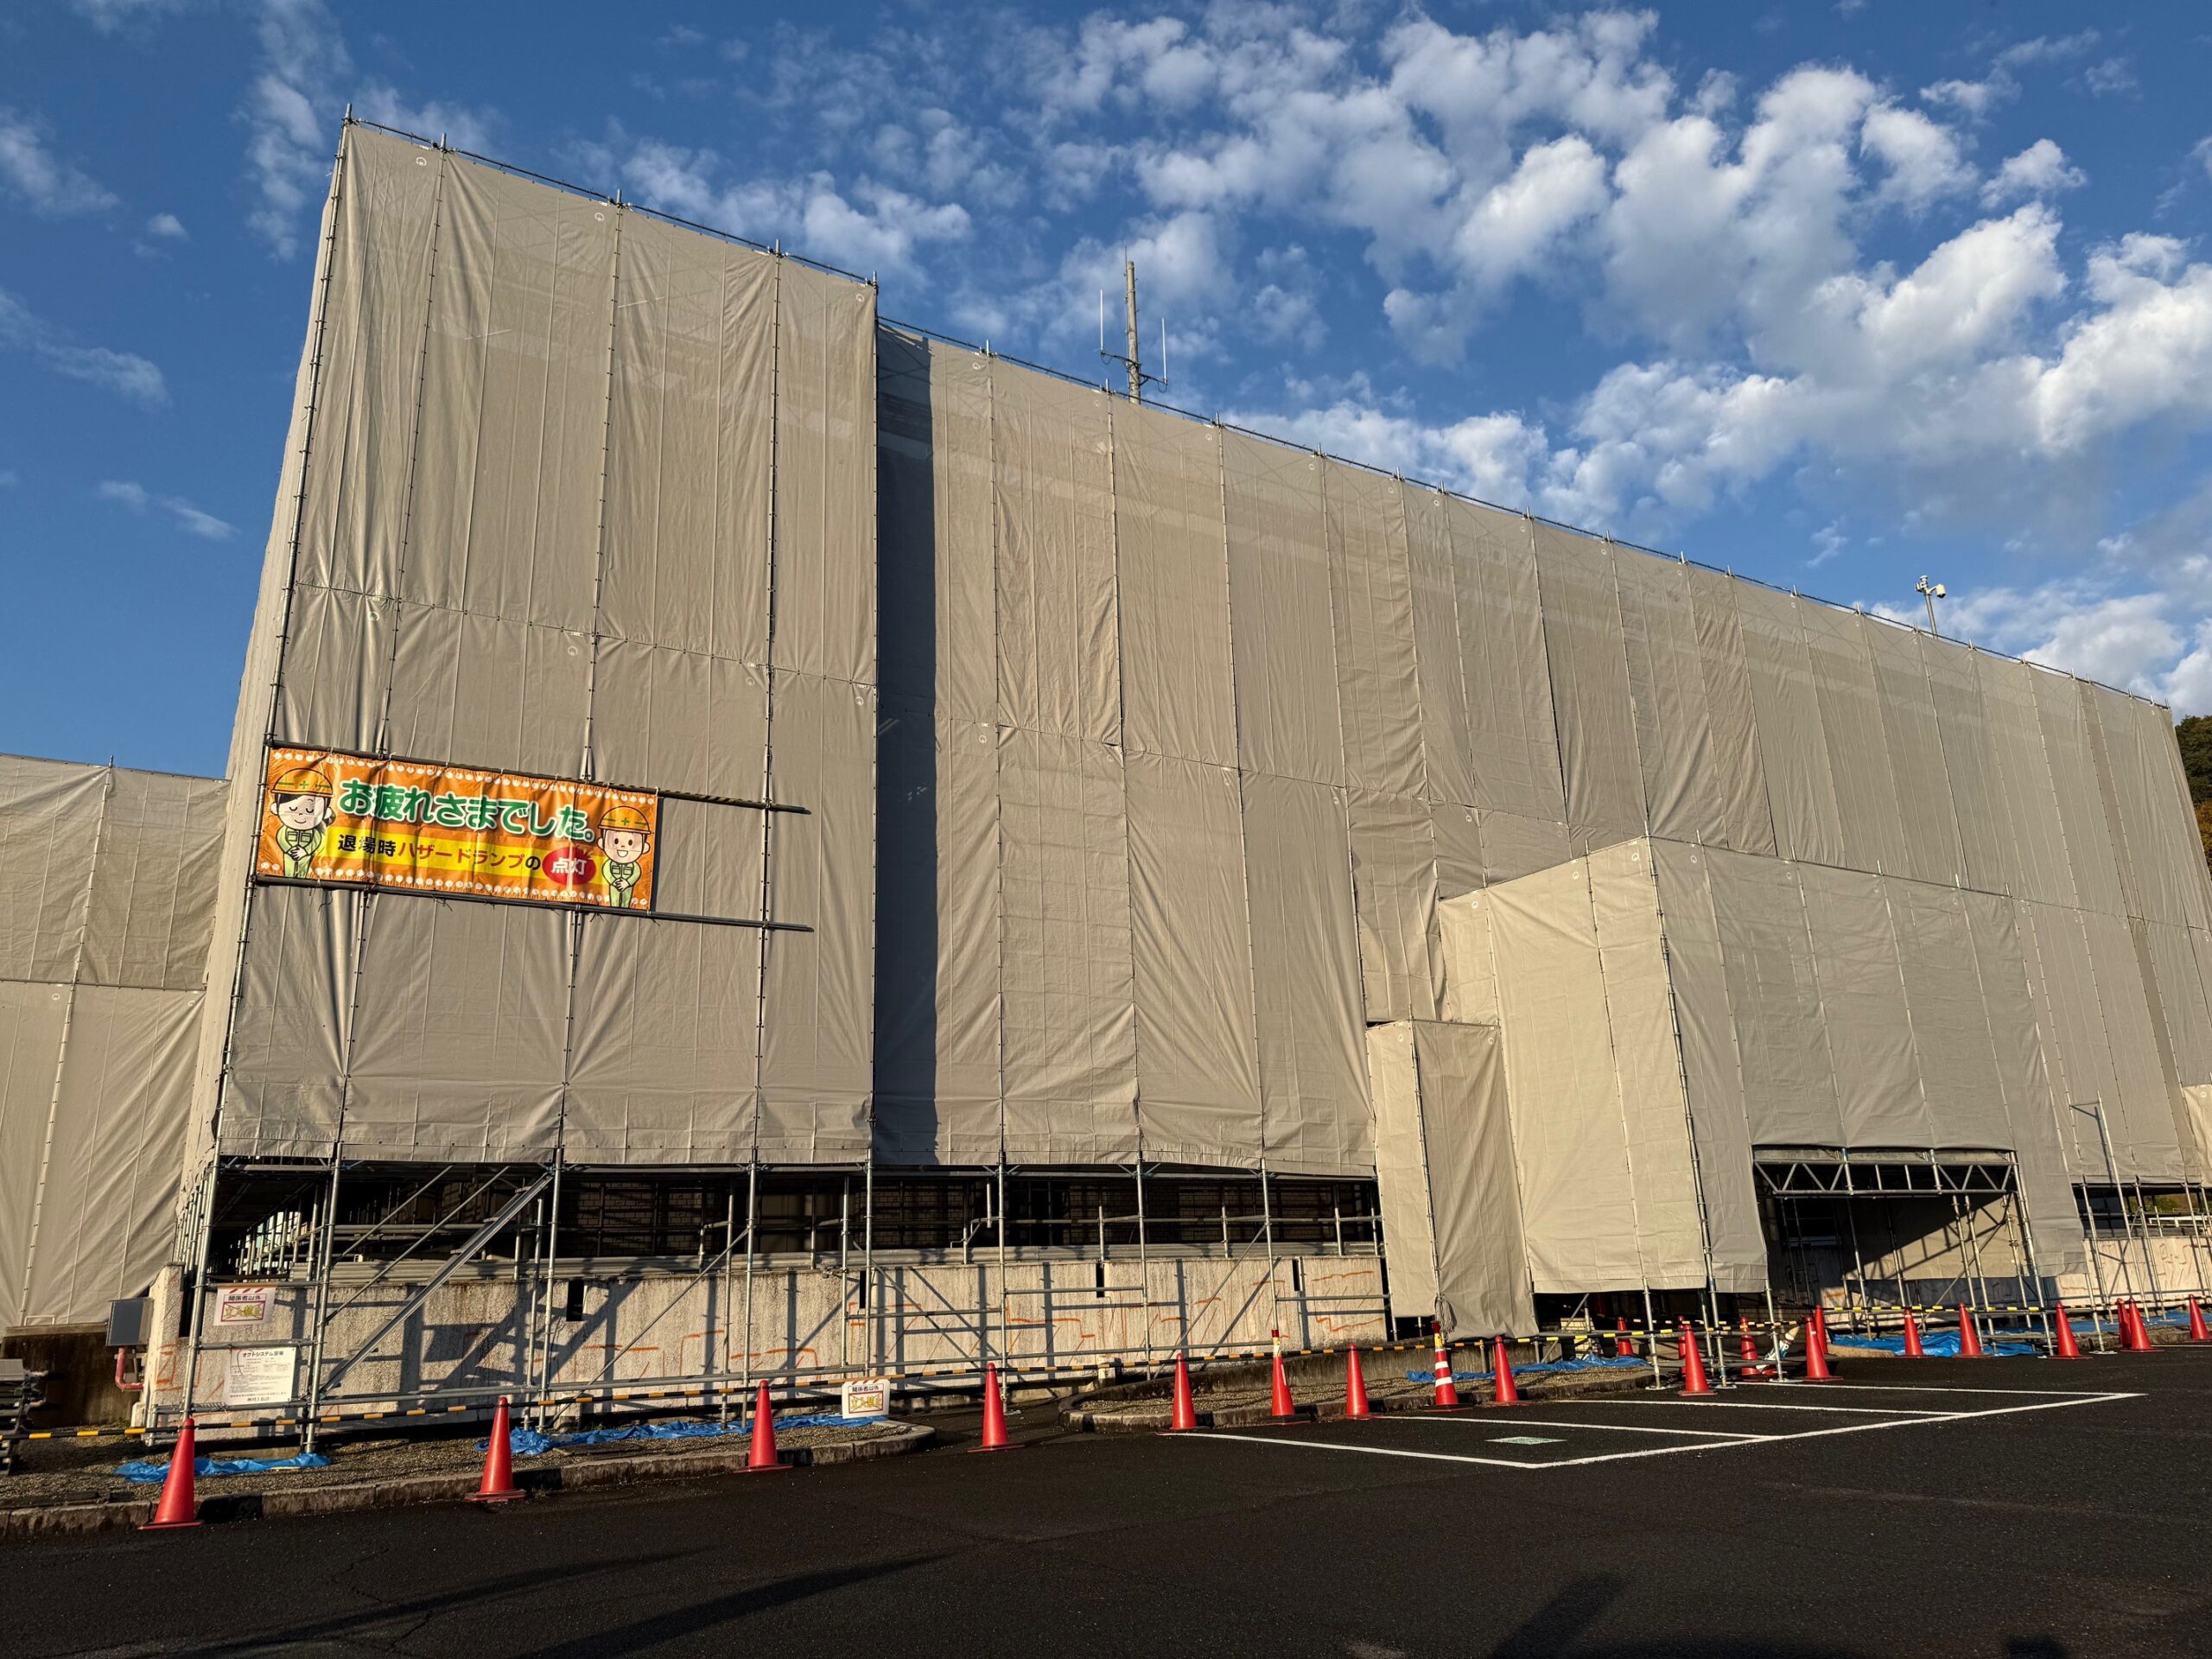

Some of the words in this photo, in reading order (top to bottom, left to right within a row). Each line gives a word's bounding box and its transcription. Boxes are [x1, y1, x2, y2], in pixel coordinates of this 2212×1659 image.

[337, 779, 594, 842] お疲れさまでした。
